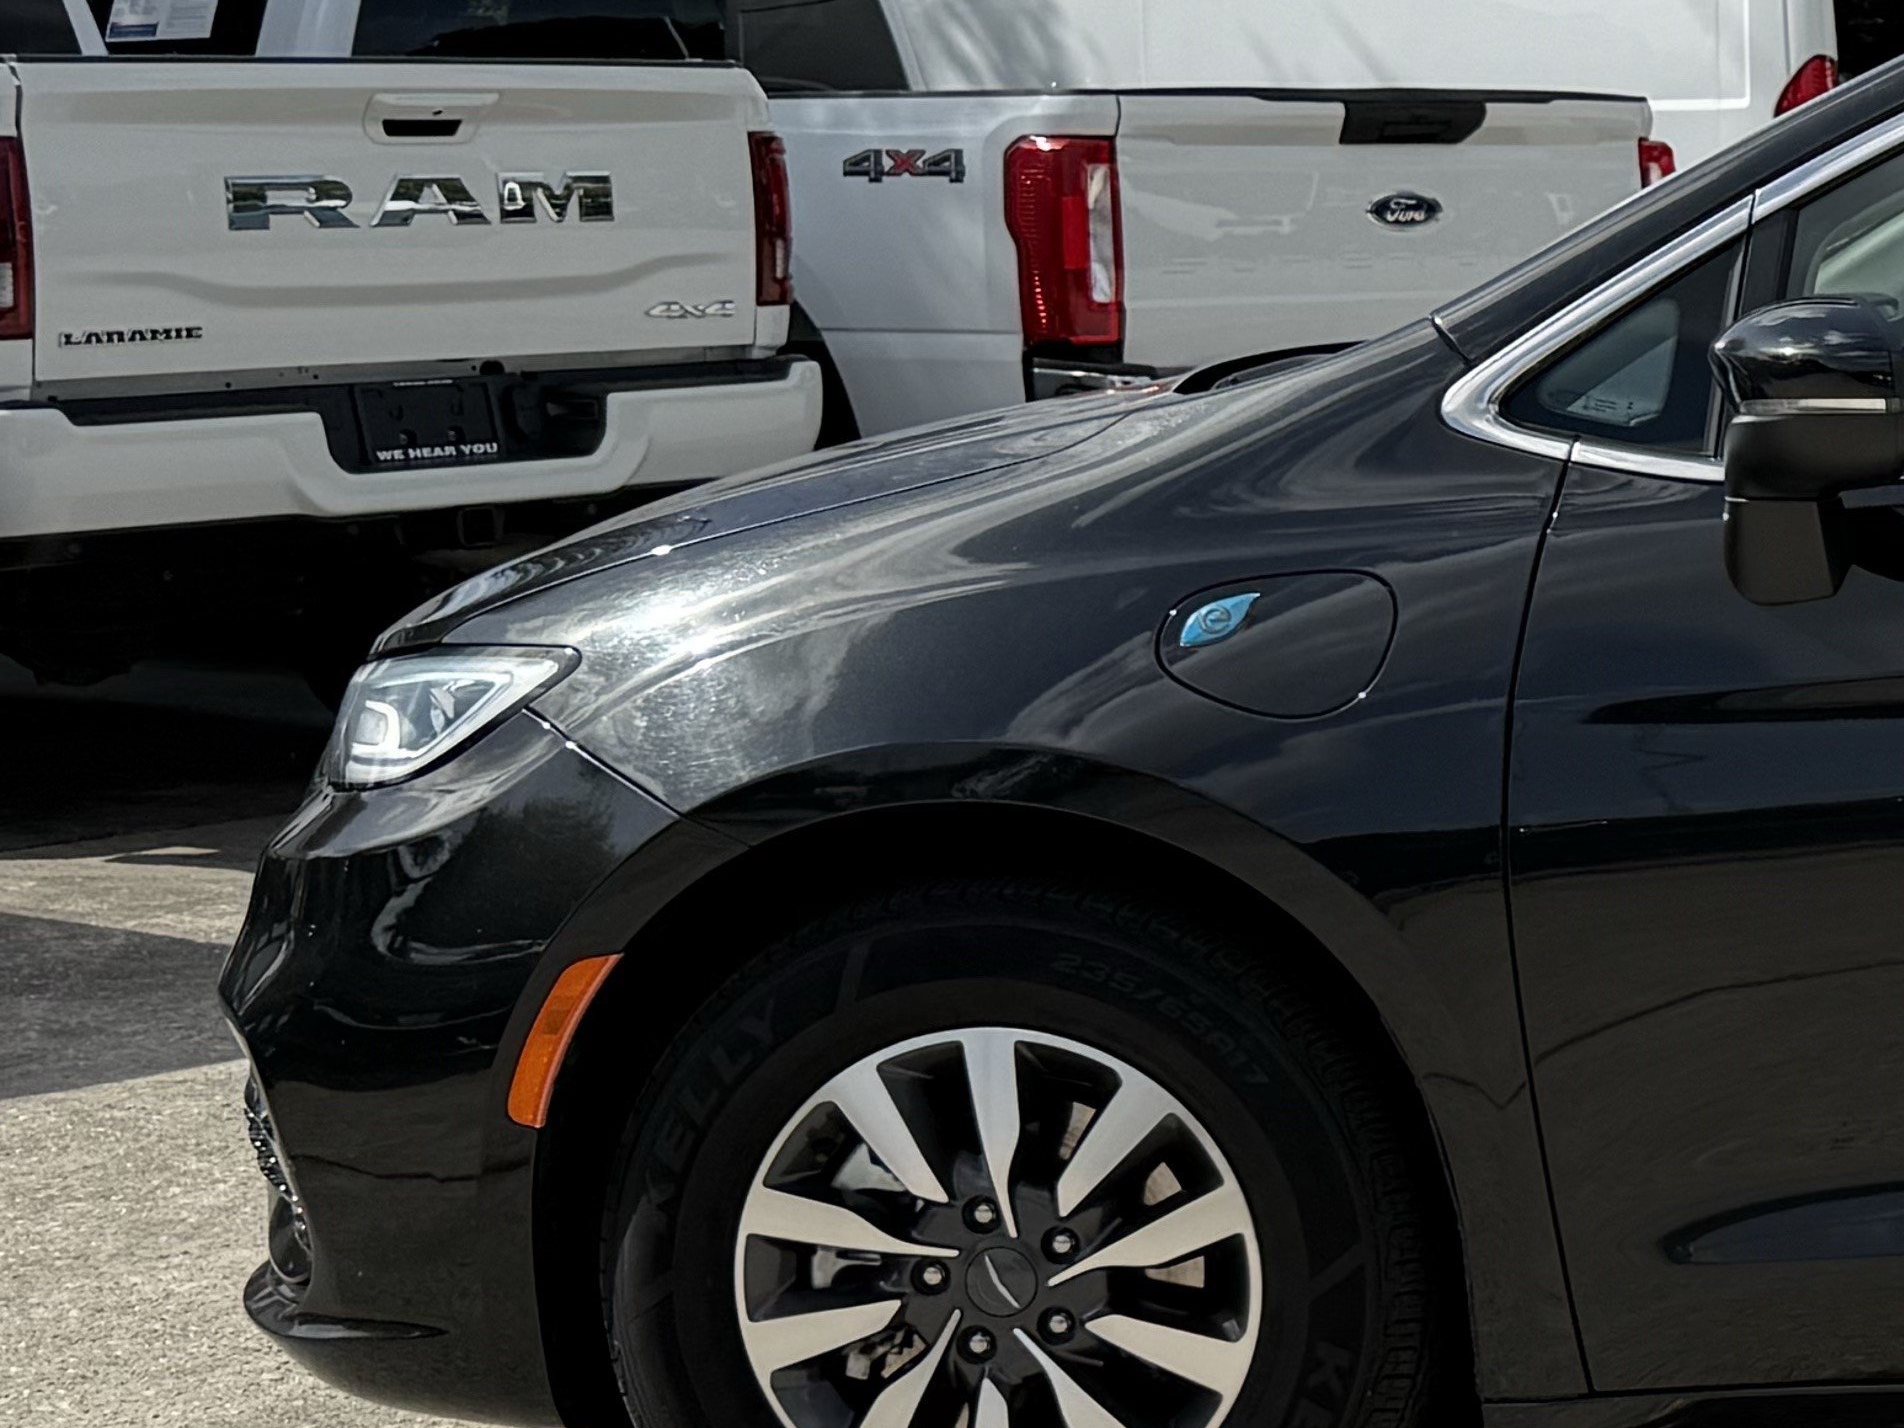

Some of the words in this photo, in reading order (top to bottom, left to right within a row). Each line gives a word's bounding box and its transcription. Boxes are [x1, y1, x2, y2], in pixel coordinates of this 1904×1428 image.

[224, 172, 616, 231] RAM
[1386, 198, 1427, 222] Ford
[59, 325, 203, 348] LARAMIE
[376, 448, 405, 461] WE
[407, 445, 457, 460] HEAR
[460, 442, 498, 455] YOU
